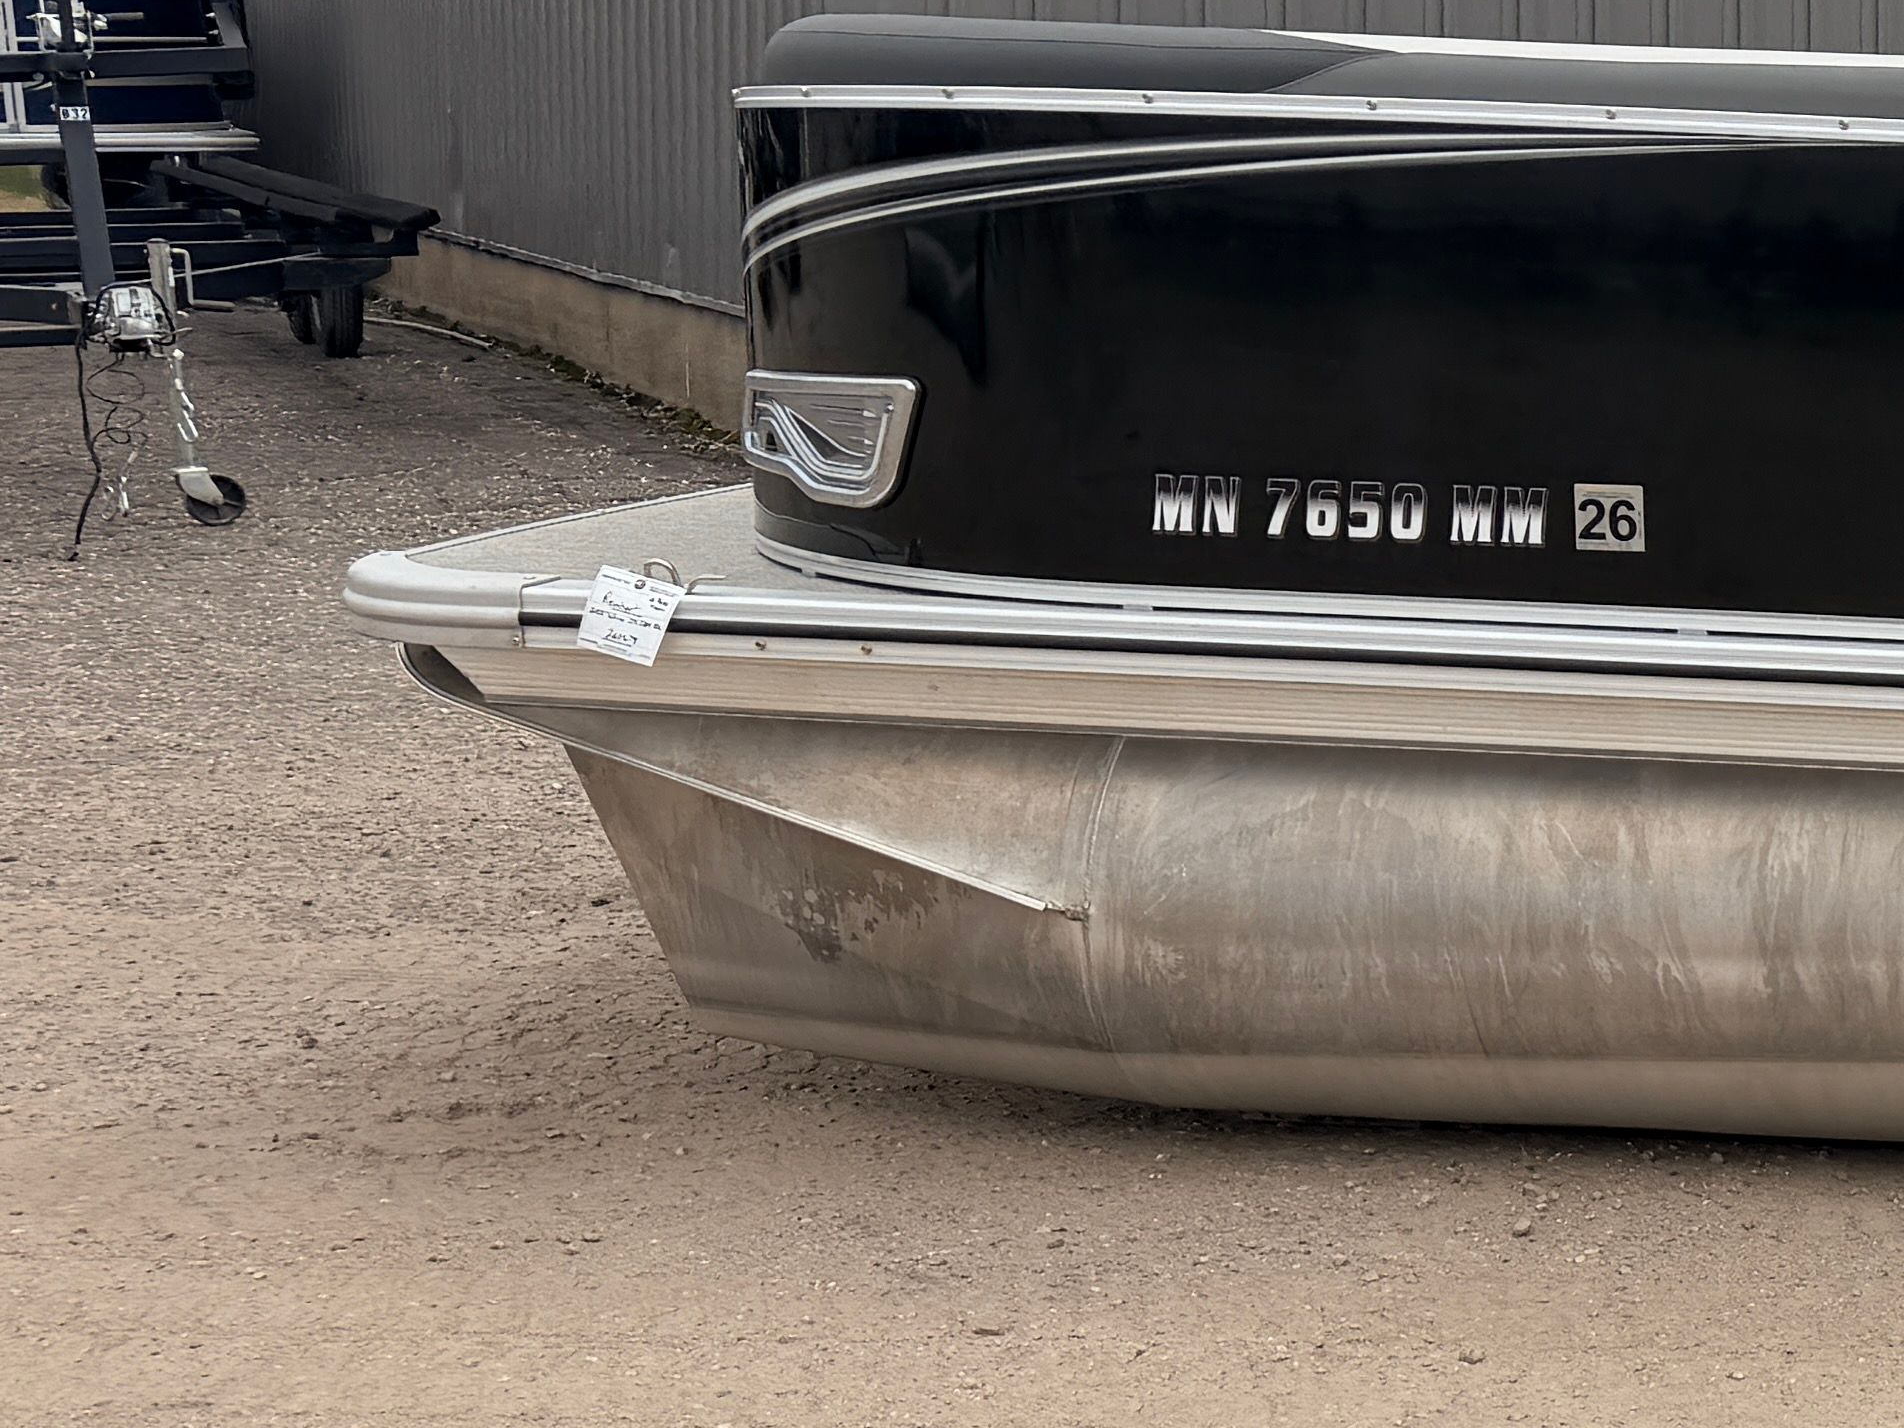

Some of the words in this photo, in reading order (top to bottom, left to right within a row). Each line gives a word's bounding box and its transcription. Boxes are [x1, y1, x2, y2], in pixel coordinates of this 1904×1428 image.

[1152, 474, 1241, 536] MN
[1266, 478, 1428, 543] 7650
[1450, 484, 1548, 548] MM
[1579, 499, 1637, 541] 26
